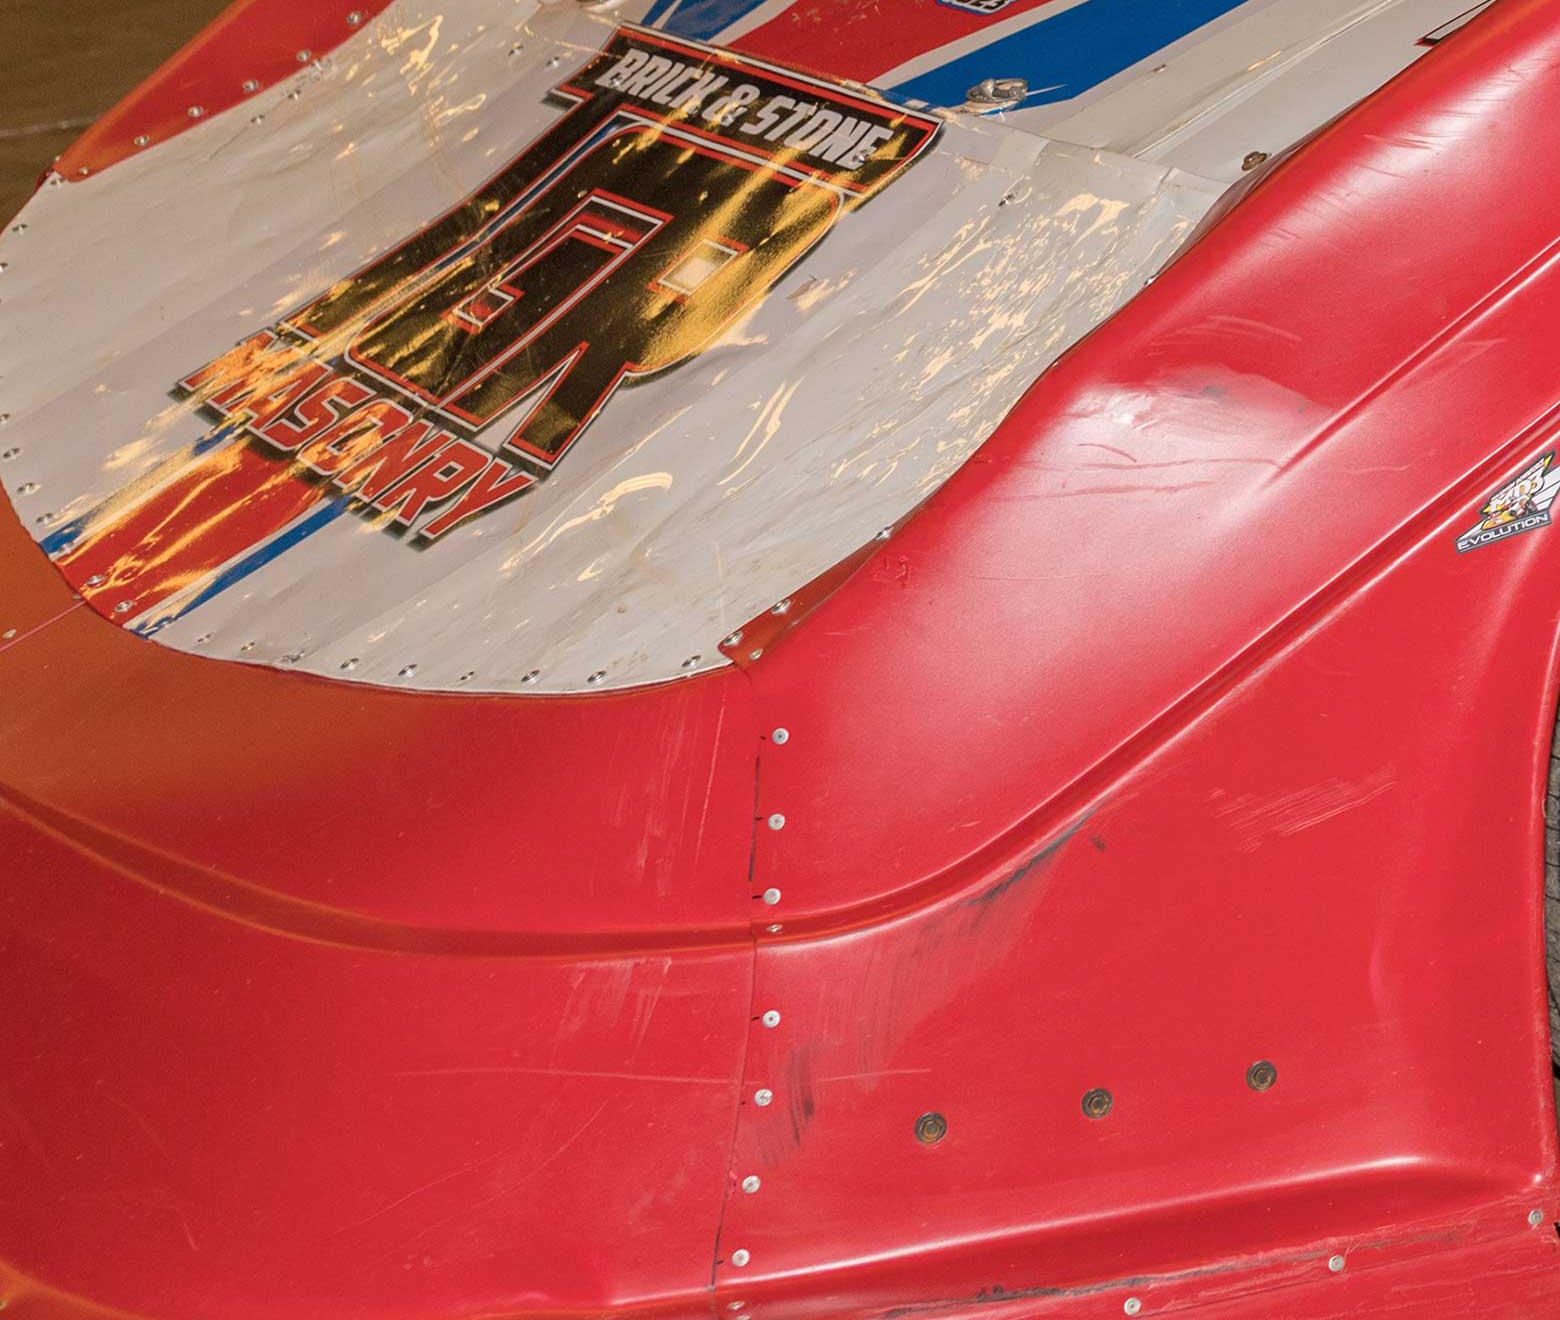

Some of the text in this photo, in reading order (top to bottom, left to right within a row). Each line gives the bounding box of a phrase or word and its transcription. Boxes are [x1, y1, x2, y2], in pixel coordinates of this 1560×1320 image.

[596, 49, 892, 170] BRICK & STONE
[179, 328, 537, 542] MASONRY
[1457, 513, 1549, 551] EVOLUTION
